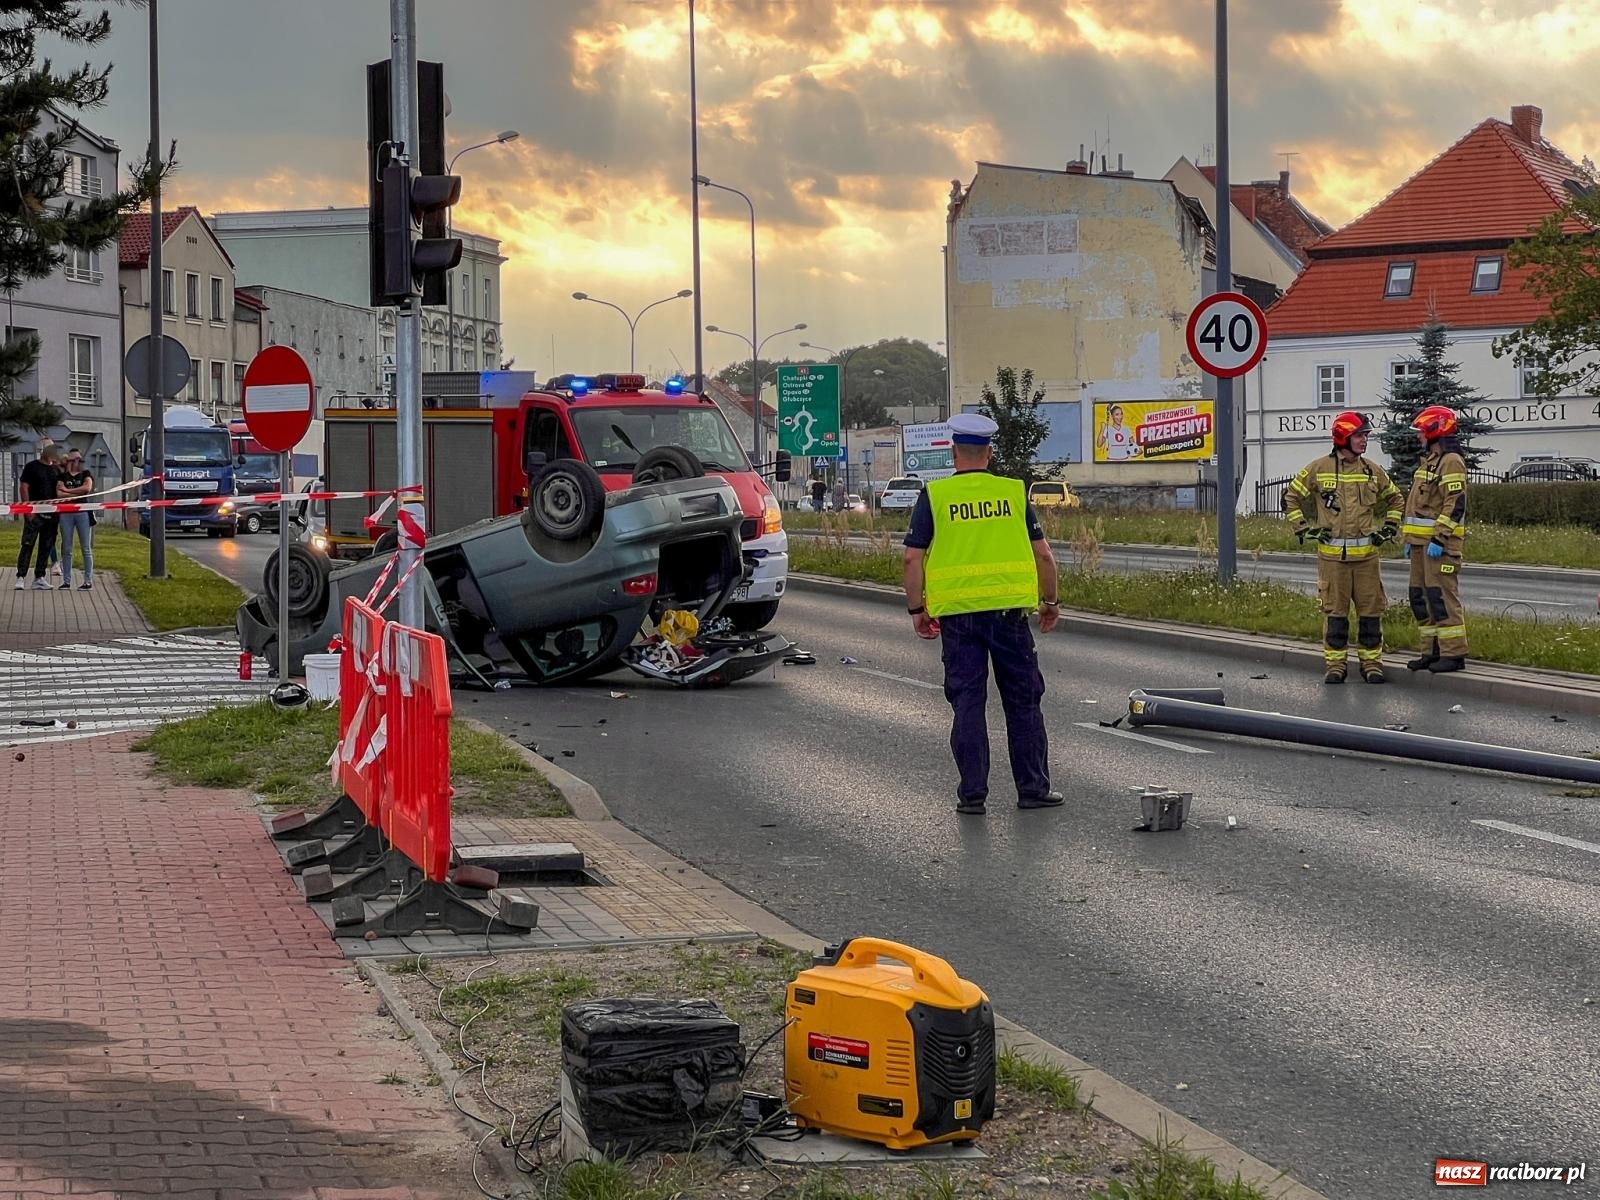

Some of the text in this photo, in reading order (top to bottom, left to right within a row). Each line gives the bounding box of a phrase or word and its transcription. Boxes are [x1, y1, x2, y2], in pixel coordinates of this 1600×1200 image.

[1200, 313, 1253, 353] 40
[1146, 407, 1194, 423] MISTRZOWSKIE
[1460, 403, 1567, 424] NOCLEGI
[1140, 417, 1208, 442] PRZECENY!
[1146, 440, 1194, 454] mediaexpert
[167, 468, 211, 479] Transport
[949, 499, 1012, 521] POLICJA
